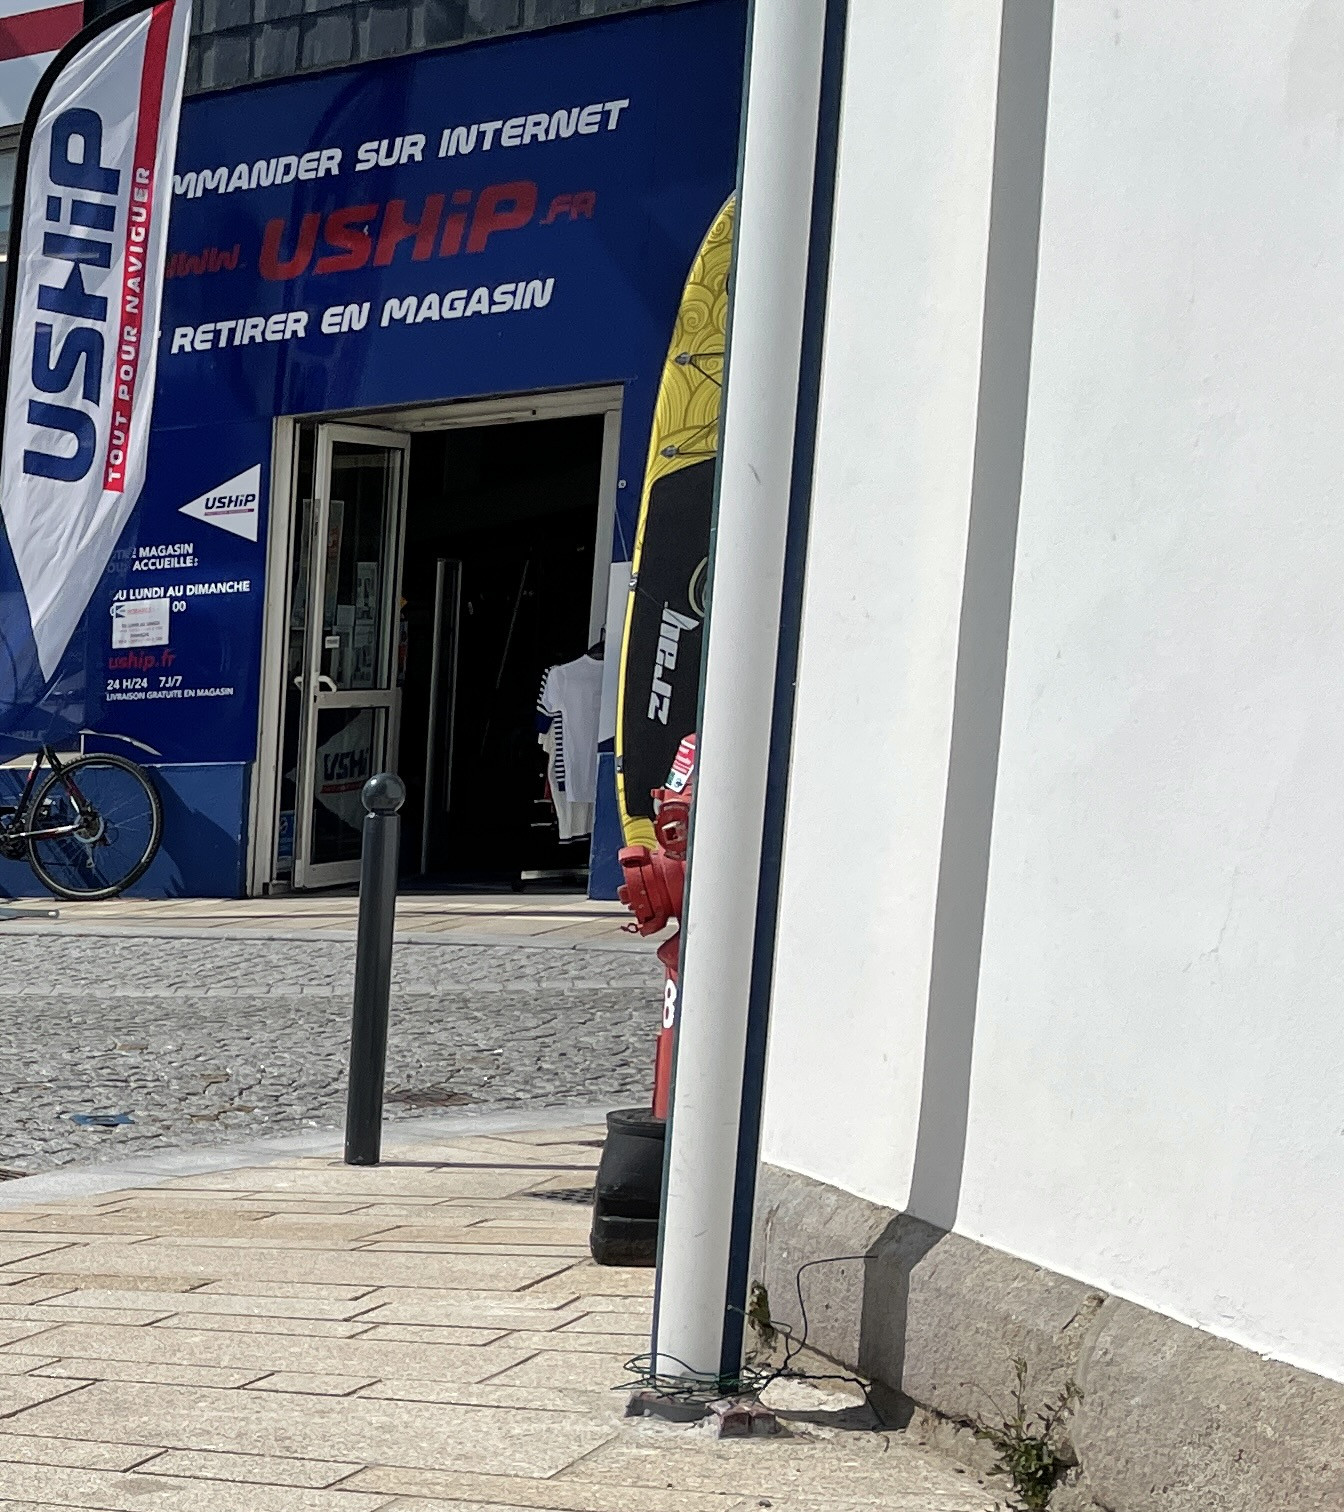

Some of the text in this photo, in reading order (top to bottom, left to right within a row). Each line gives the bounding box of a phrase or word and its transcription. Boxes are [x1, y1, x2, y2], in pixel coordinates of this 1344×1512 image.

[171, 99, 630, 199] MMANDER SUR INTERNET
[108, 167, 151, 482] TOUT POUR NAVIGUER
[170, 278, 555, 354] RETIRER EN MAGASIN
[138, 543, 194, 558] MAGASIN
[129, 586, 165, 600] LUNDI
[166, 585, 184, 598] AU
[186, 580, 251, 595] DIMANCHE
[108, 649, 177, 672] uship.fr
[106, 679, 120, 691] 24
[122, 677, 149, 690] H/24
[106, 687, 234, 702] LIVRAISON GRATUITE EN MAGASIN
